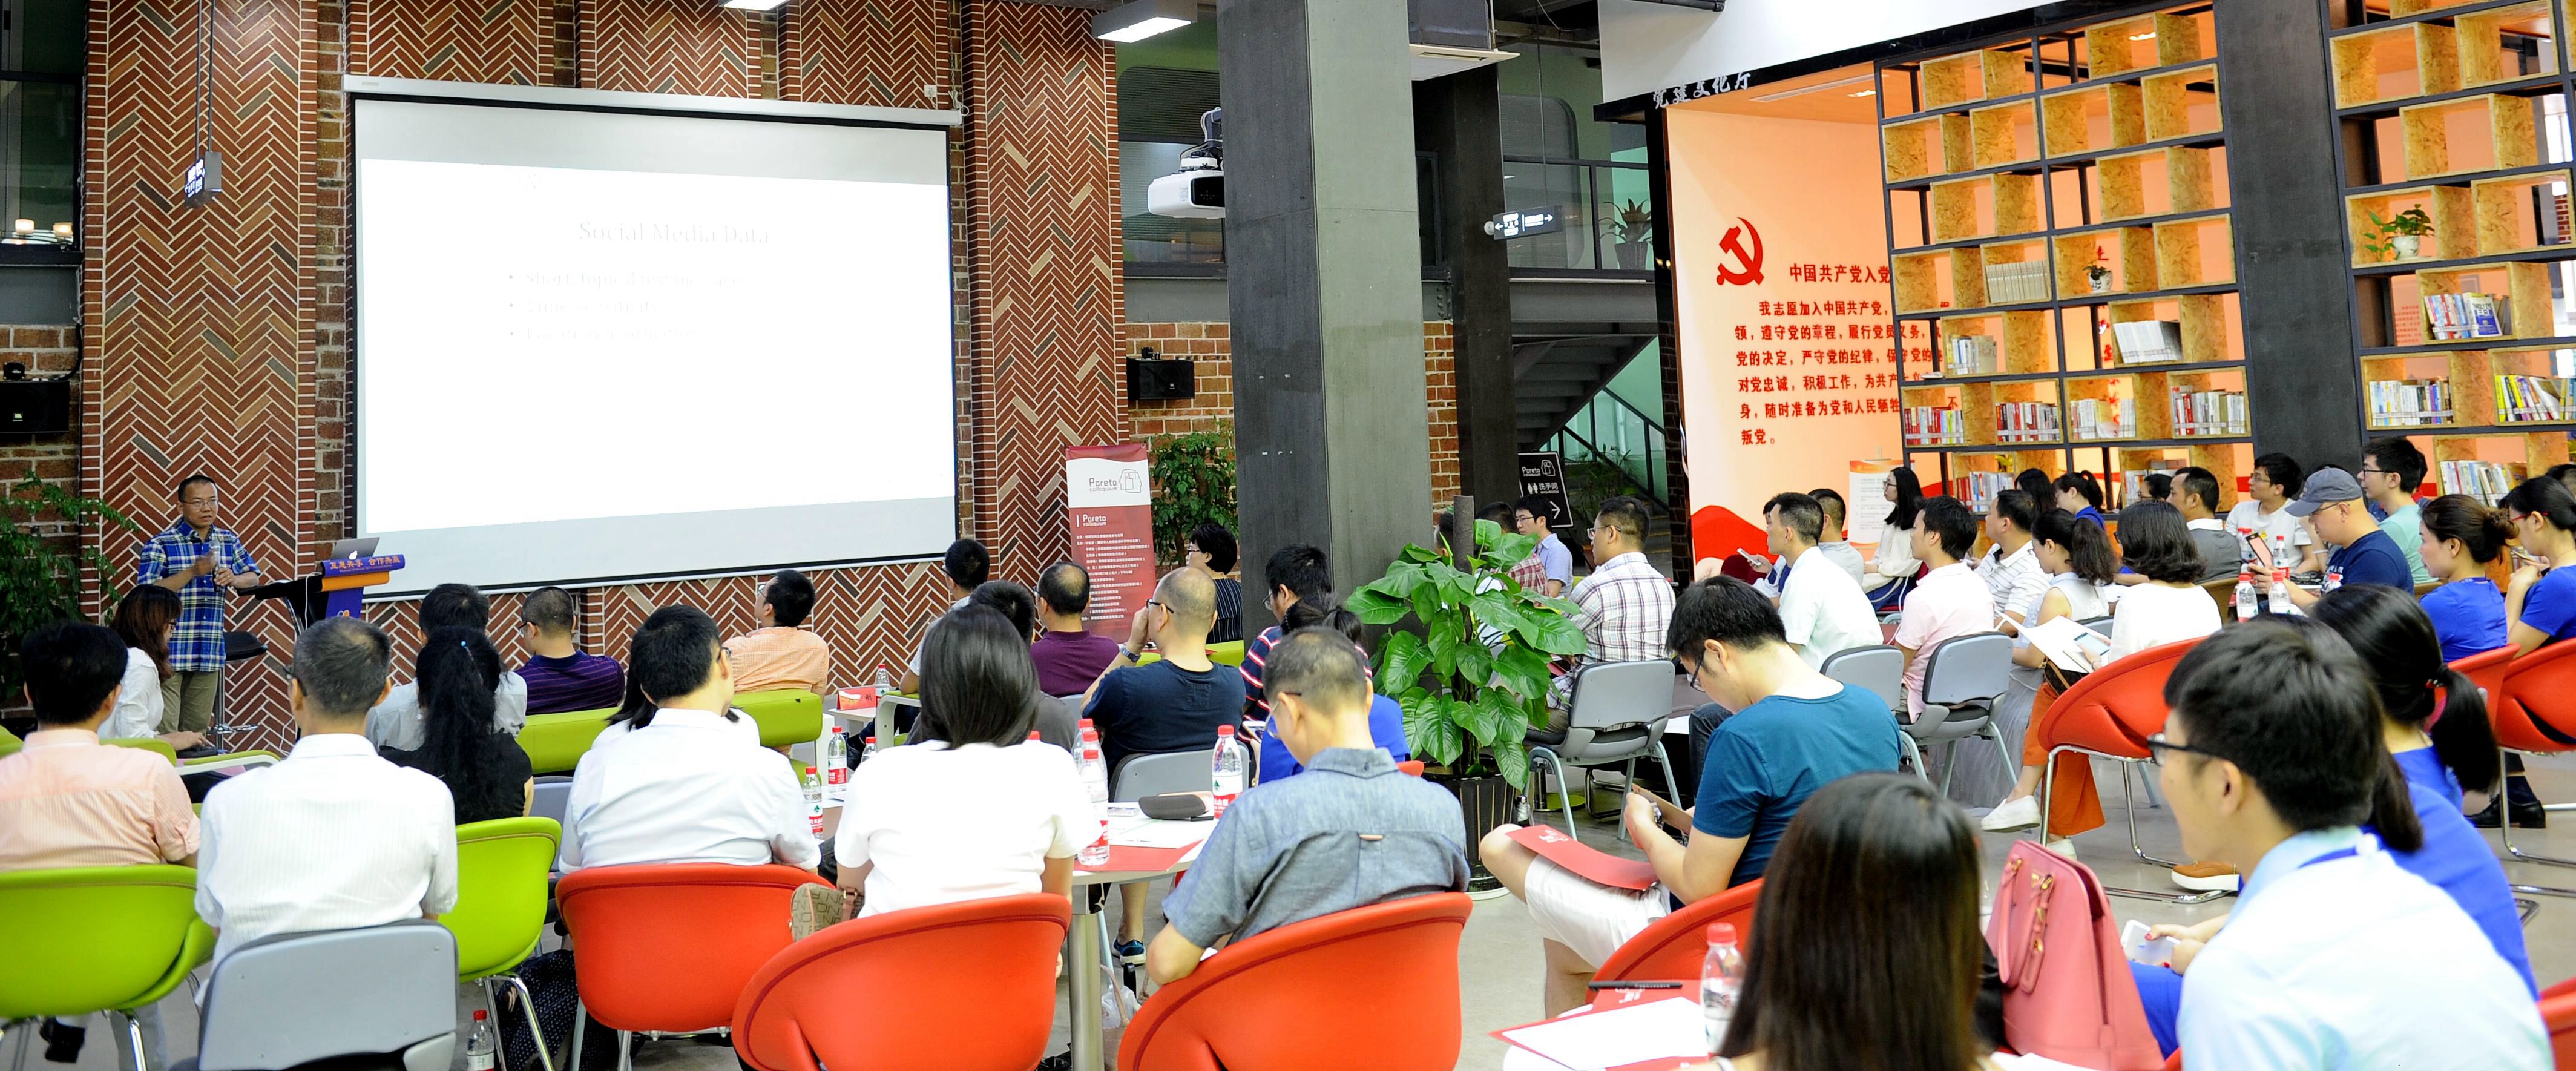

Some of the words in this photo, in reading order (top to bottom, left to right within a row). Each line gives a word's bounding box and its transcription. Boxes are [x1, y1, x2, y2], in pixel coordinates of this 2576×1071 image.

[1653, 72, 1751, 110] 党建文化厅
[579, 220, 645, 242] Social
[652, 222, 717, 243] Media
[724, 225, 770, 245] Data
[1790, 263, 1890, 283] 中国共产党入党
[1741, 428, 1775, 445] 叛党。
[1089, 477, 1117, 487] Pareto
[1539, 482, 1558, 490] 洗手间
[1082, 514, 1106, 522] Pareto
